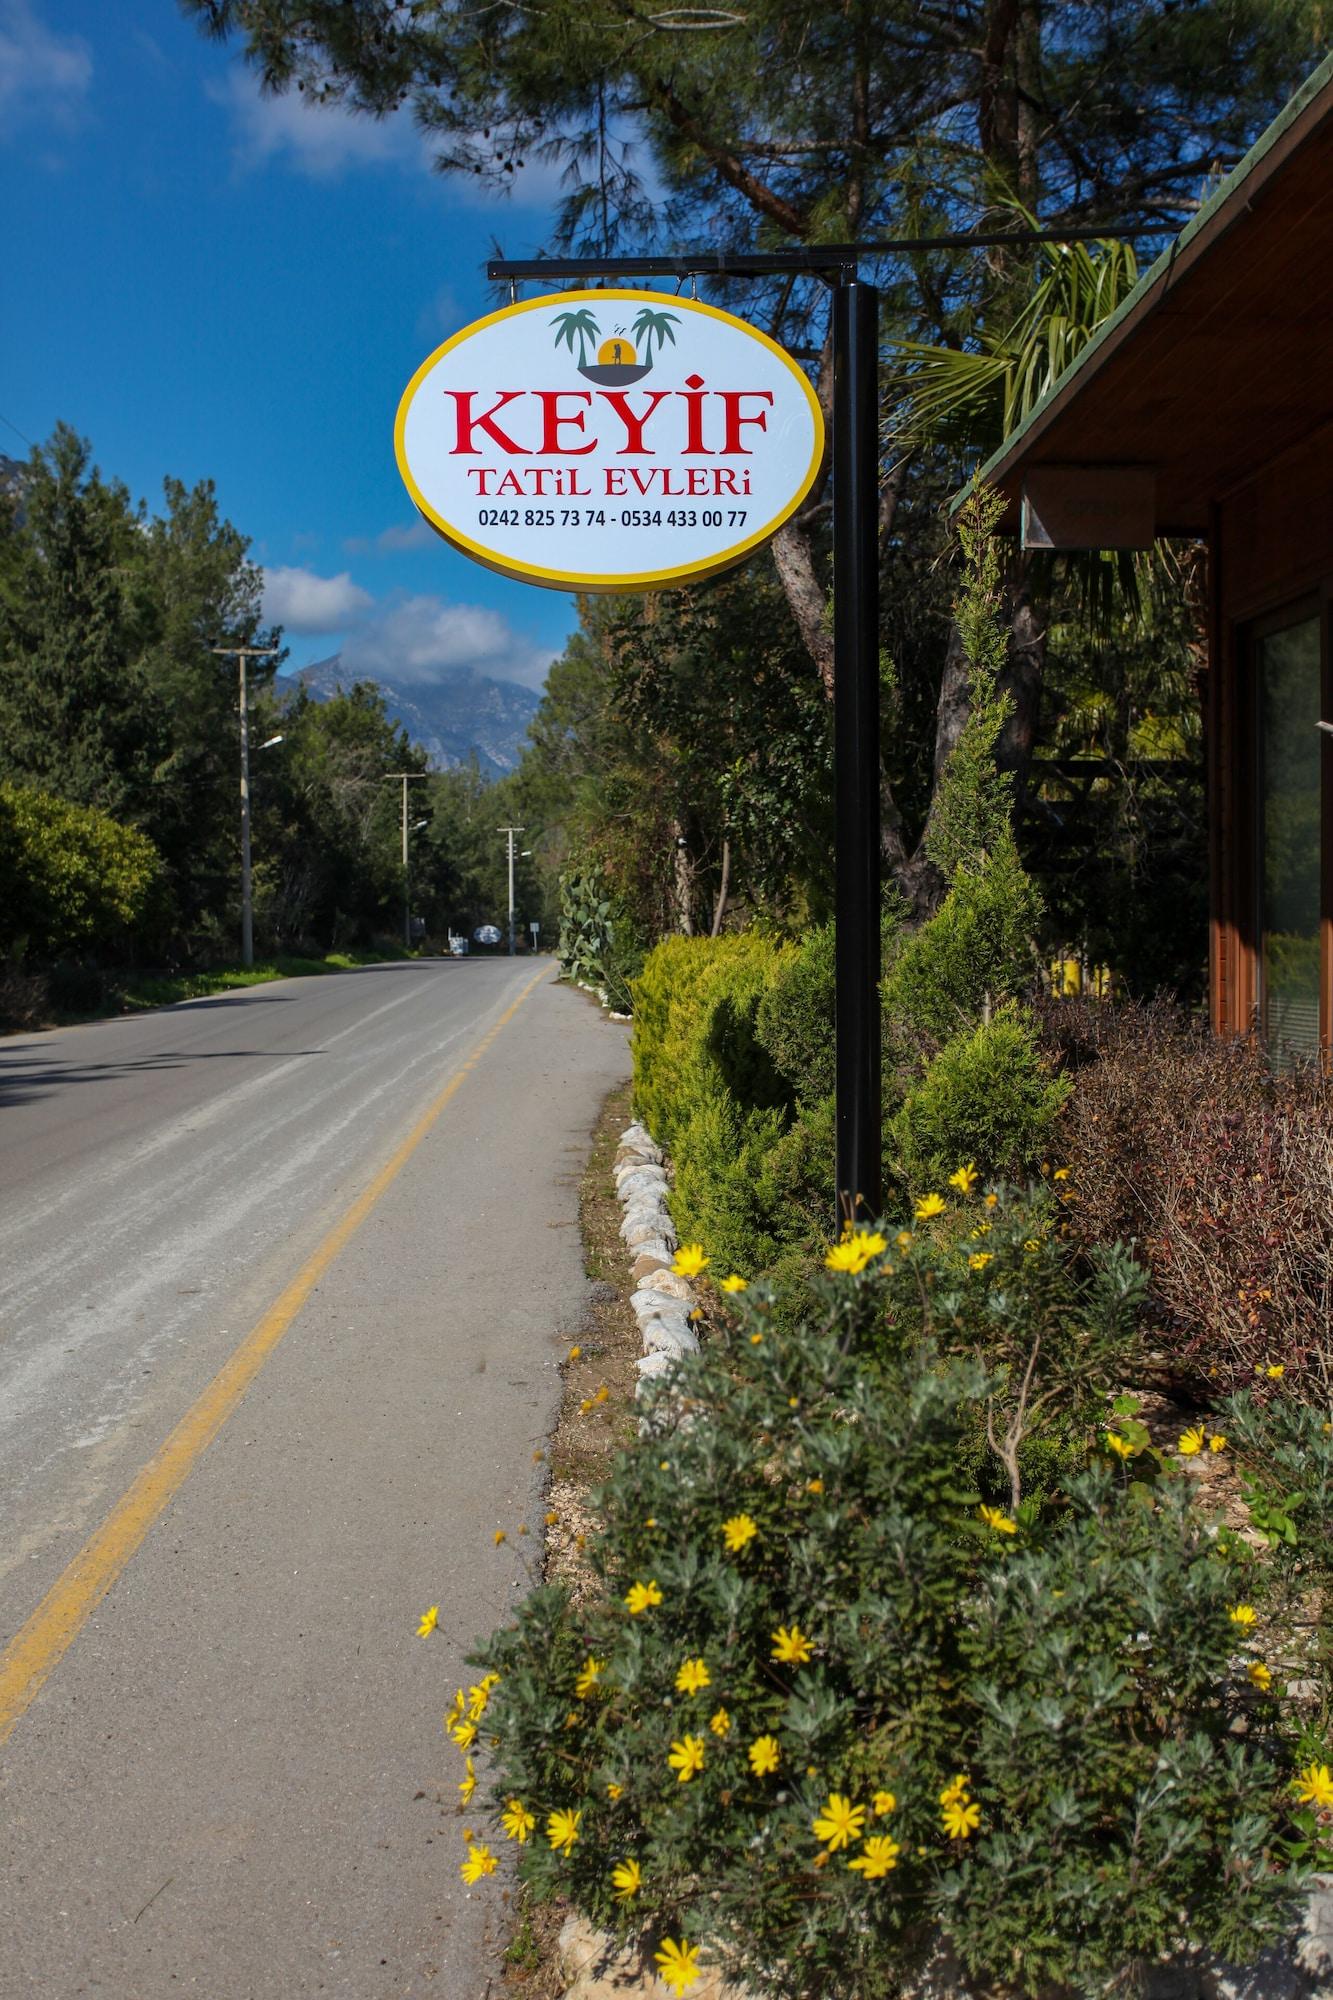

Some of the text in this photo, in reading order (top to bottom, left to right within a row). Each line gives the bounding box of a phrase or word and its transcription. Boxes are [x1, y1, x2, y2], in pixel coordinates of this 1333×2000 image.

[443, 374, 774, 456] KEYİF
[479, 510, 520, 526] 0242
[524, 510, 555, 527] 825
[561, 510, 580, 527] 73
[586, 510, 606, 527] 74
[621, 511, 662, 527] 0534
[667, 511, 698, 527] 433
[703, 511, 723, 527] 00
[727, 511, 748, 527] 77
